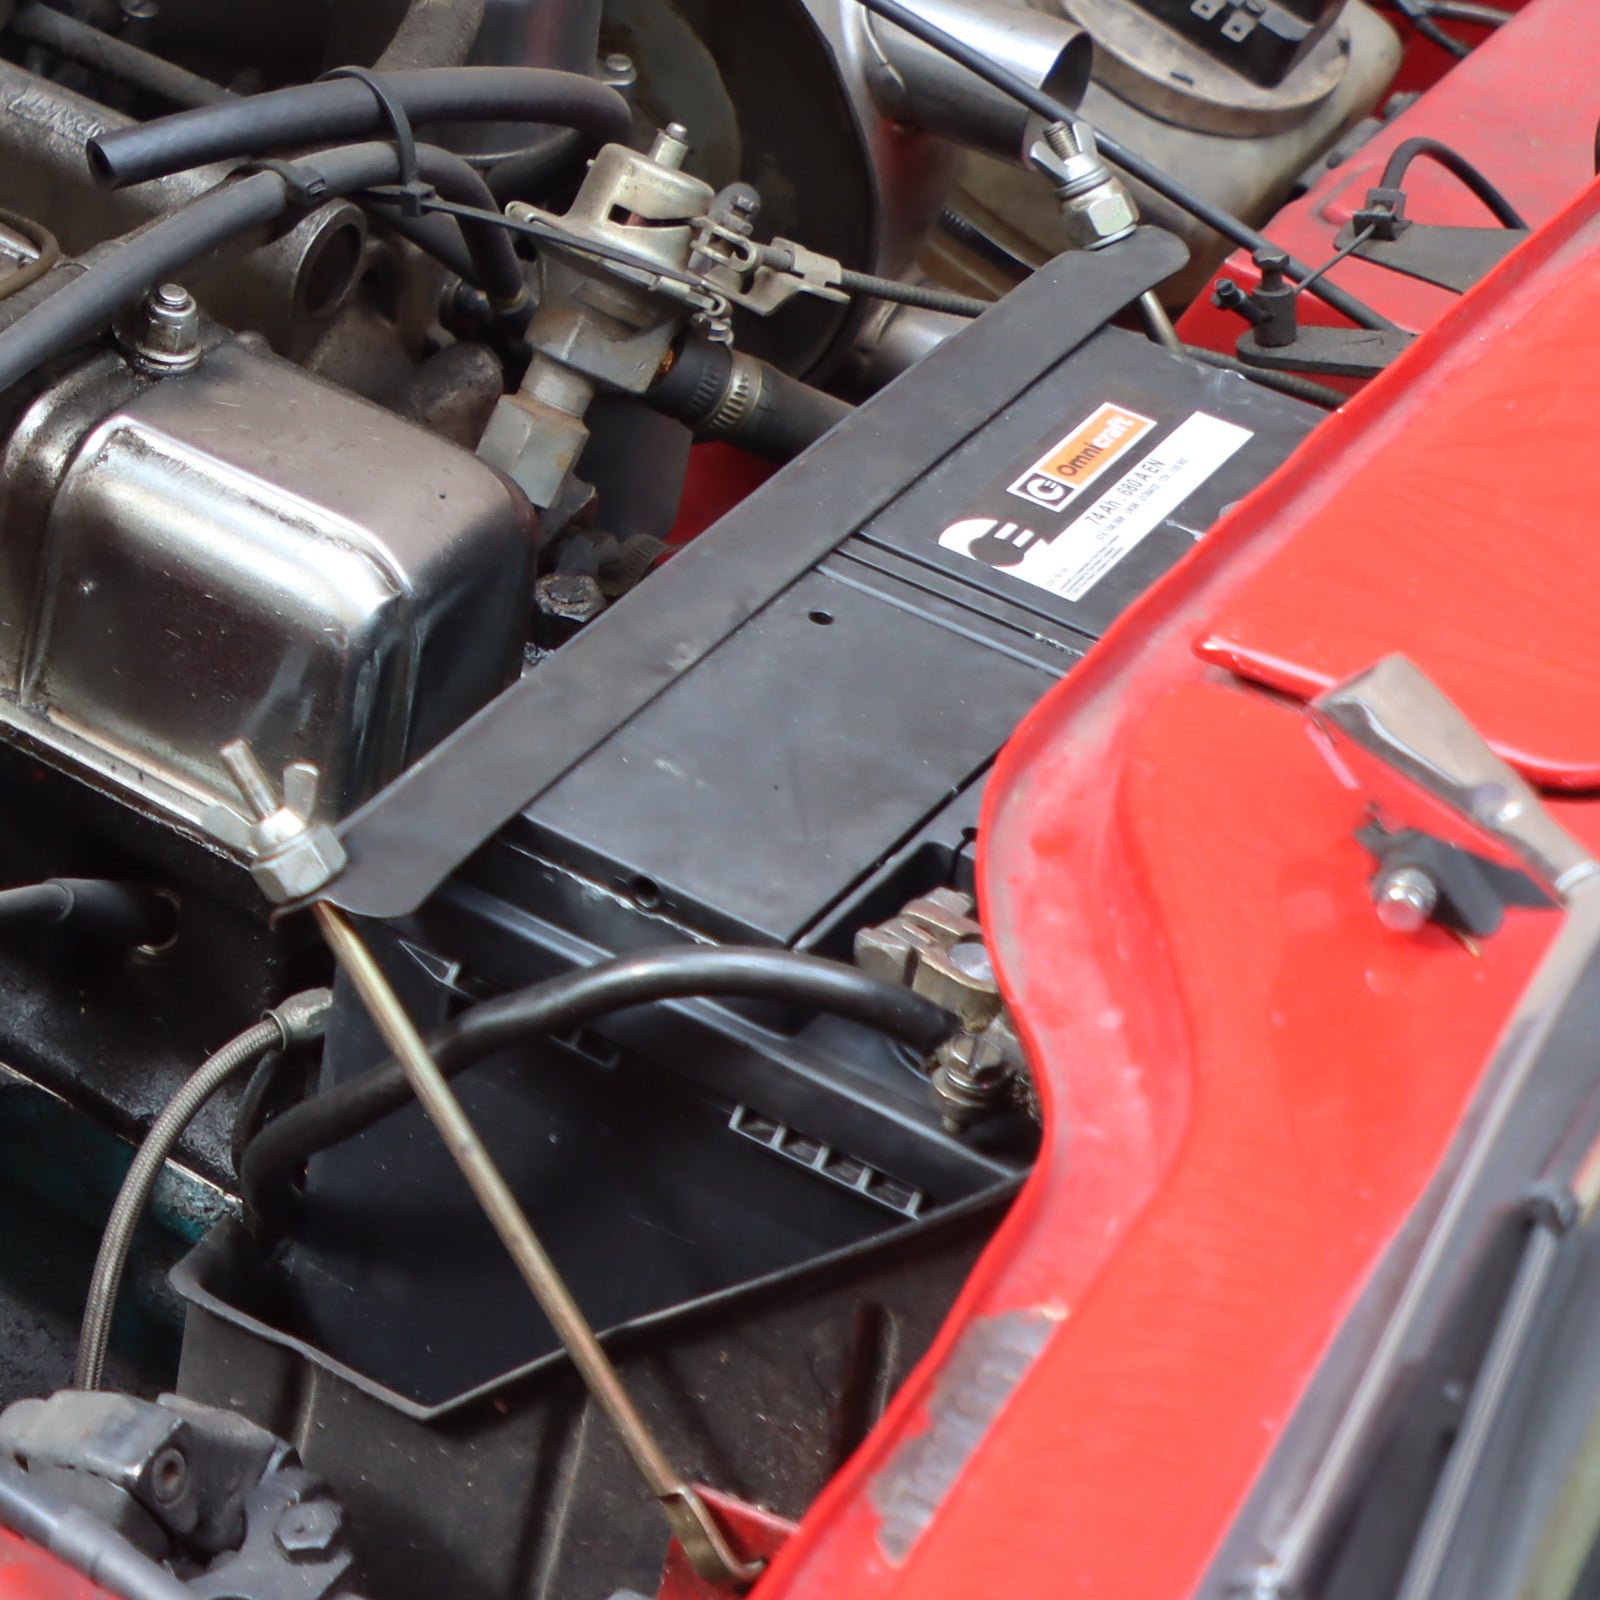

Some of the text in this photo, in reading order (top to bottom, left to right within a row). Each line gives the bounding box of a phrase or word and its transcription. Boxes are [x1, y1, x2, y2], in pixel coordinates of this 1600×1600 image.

[1055, 414, 1135, 478] Omnicraft
[1084, 458, 1166, 525] 74 Ah 680 A EN
